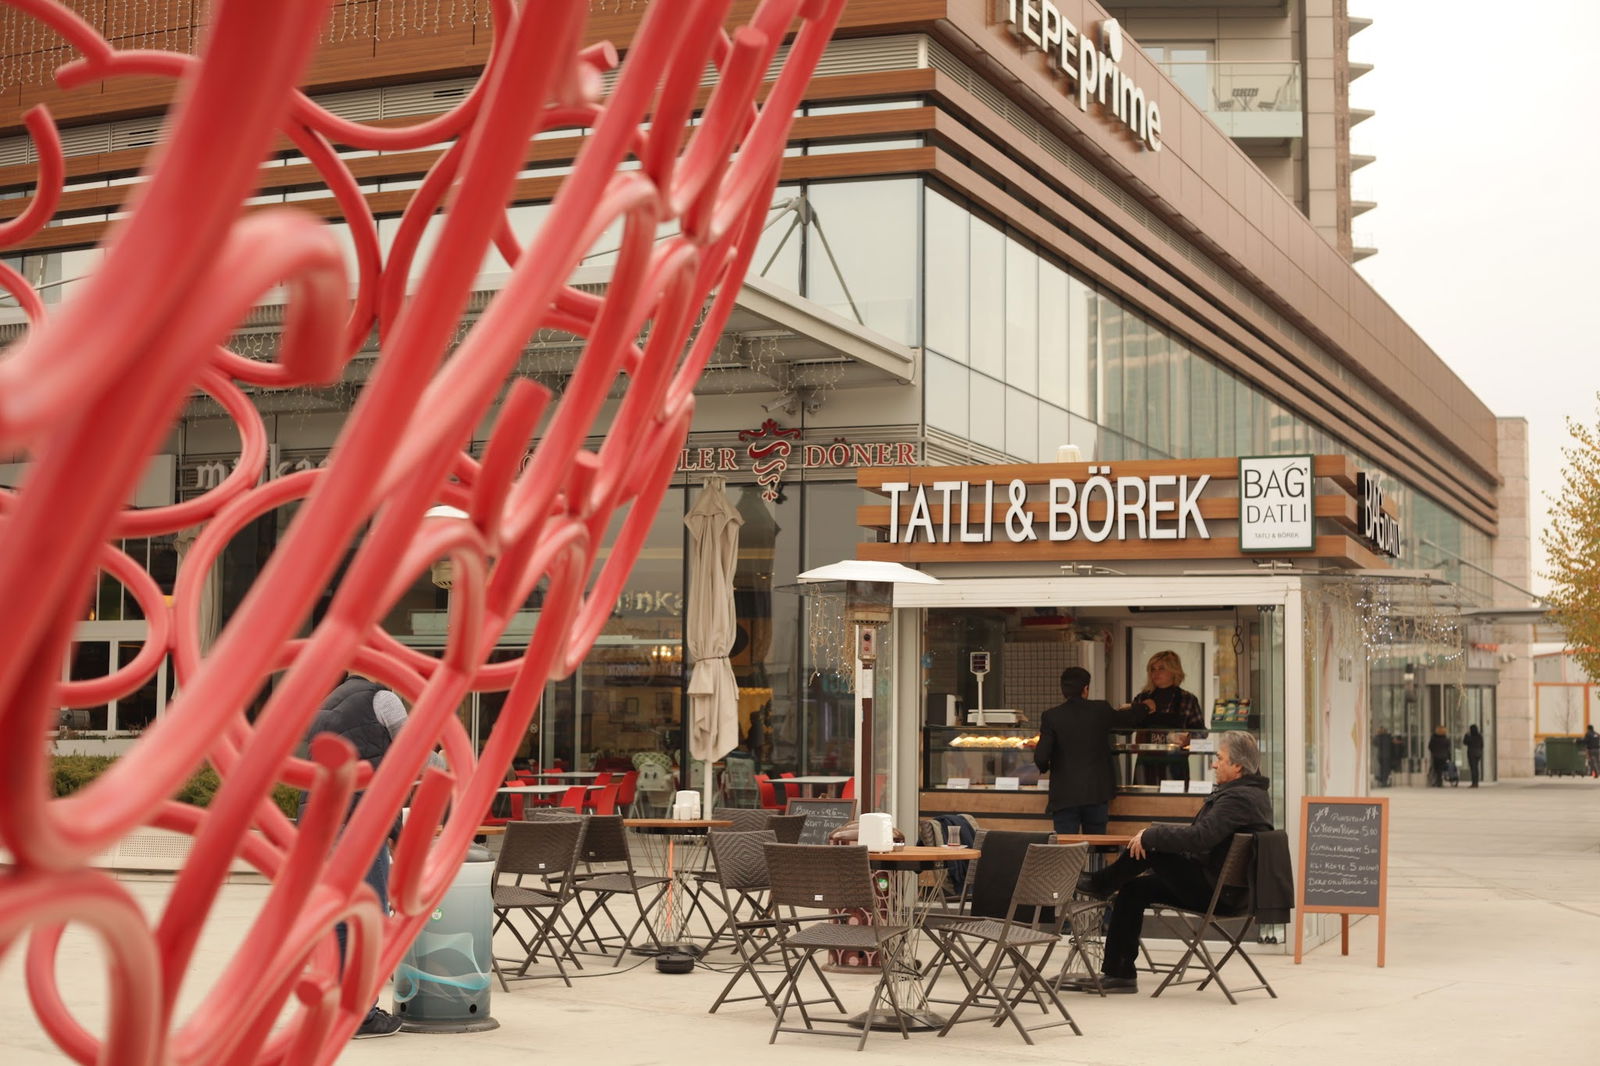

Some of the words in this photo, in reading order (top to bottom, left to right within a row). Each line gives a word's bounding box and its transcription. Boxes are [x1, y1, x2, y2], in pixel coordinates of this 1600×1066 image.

[677, 447, 739, 471] LER
[803, 437, 917, 468] DÖNER
[881, 480, 995, 544] TATLI
[1005, 478, 1037, 543] &
[1049, 465, 1212, 544] BÖREK
[1247, 504, 1307, 524] DATLI
